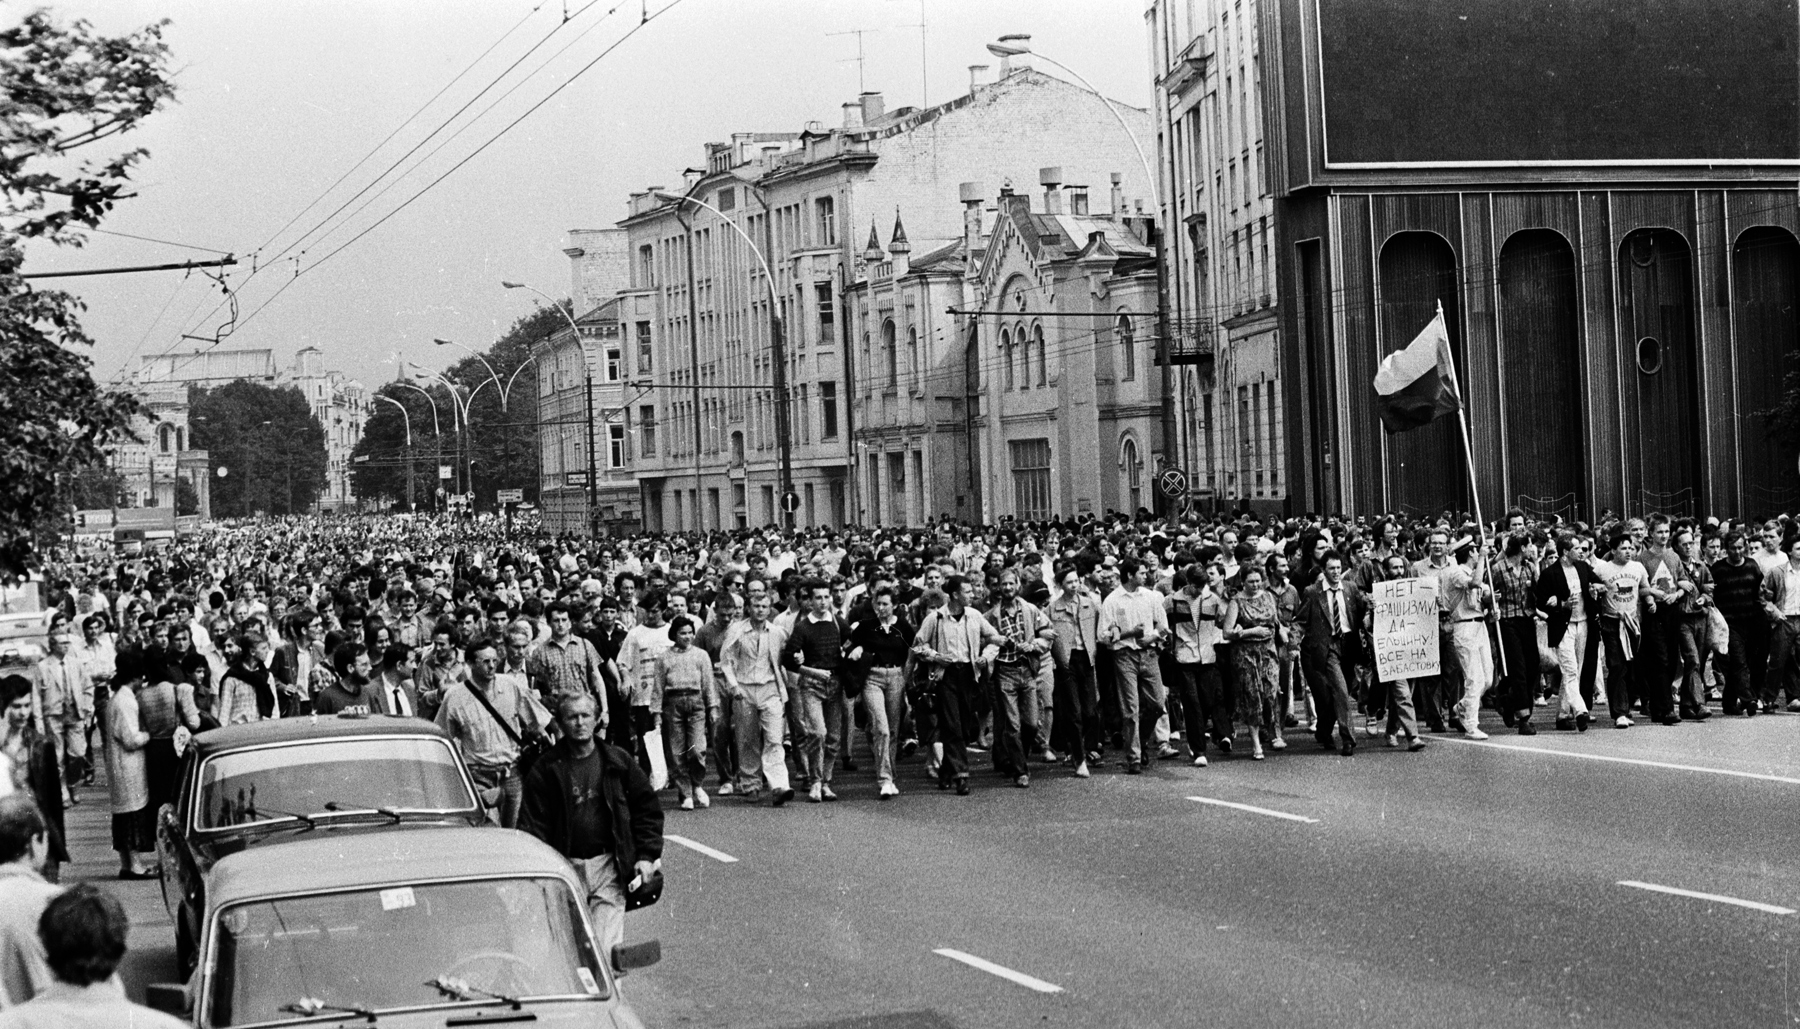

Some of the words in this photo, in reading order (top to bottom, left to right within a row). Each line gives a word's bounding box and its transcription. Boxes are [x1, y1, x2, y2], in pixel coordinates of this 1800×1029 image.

[1608, 573, 1639, 583] OKLAHOMA
[1376, 600, 1437, 617] ФАШИЗМУ!
[1377, 631, 1434, 649] ЕЛЬЦИНУ!
[1378, 650, 1405, 665] ВСЕ
[1411, 648, 1426, 659] НА
[1381, 661, 1440, 676] ЗАБАСТОВКУ
